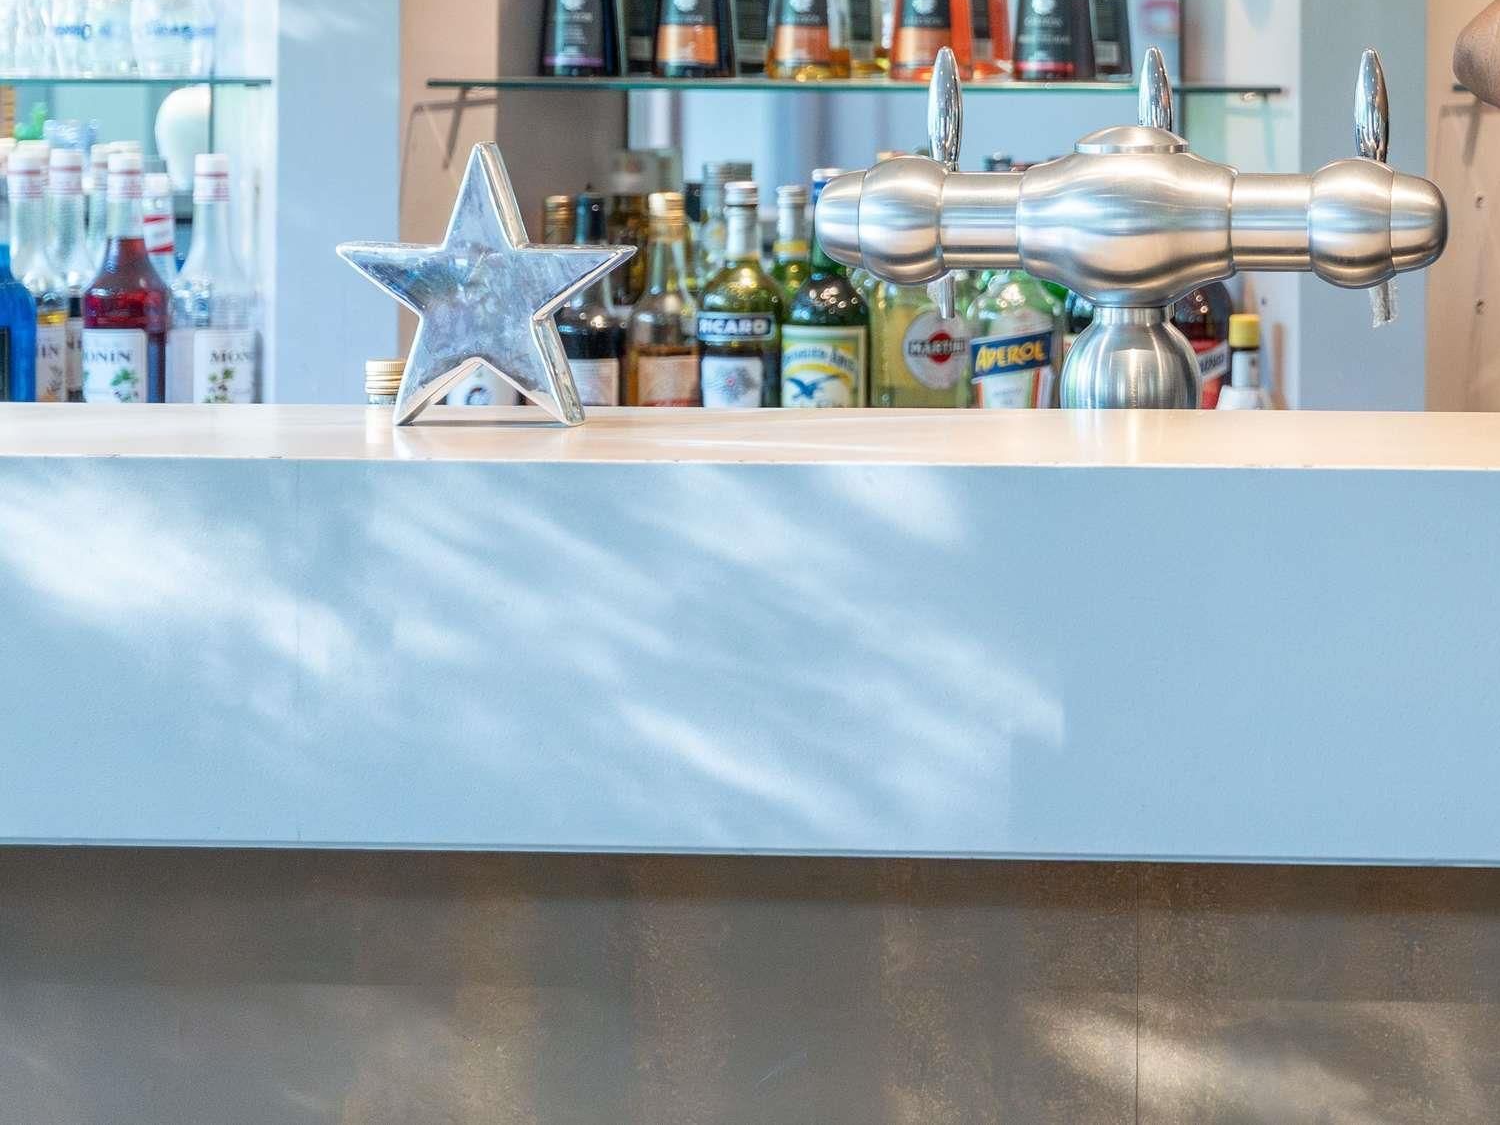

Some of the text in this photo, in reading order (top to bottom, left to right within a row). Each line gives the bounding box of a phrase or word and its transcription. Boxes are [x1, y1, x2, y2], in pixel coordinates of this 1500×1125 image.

[84, 349, 132, 364] ONIN
[908, 338, 967, 357] MARTINI
[975, 340, 1045, 374] APEROL
